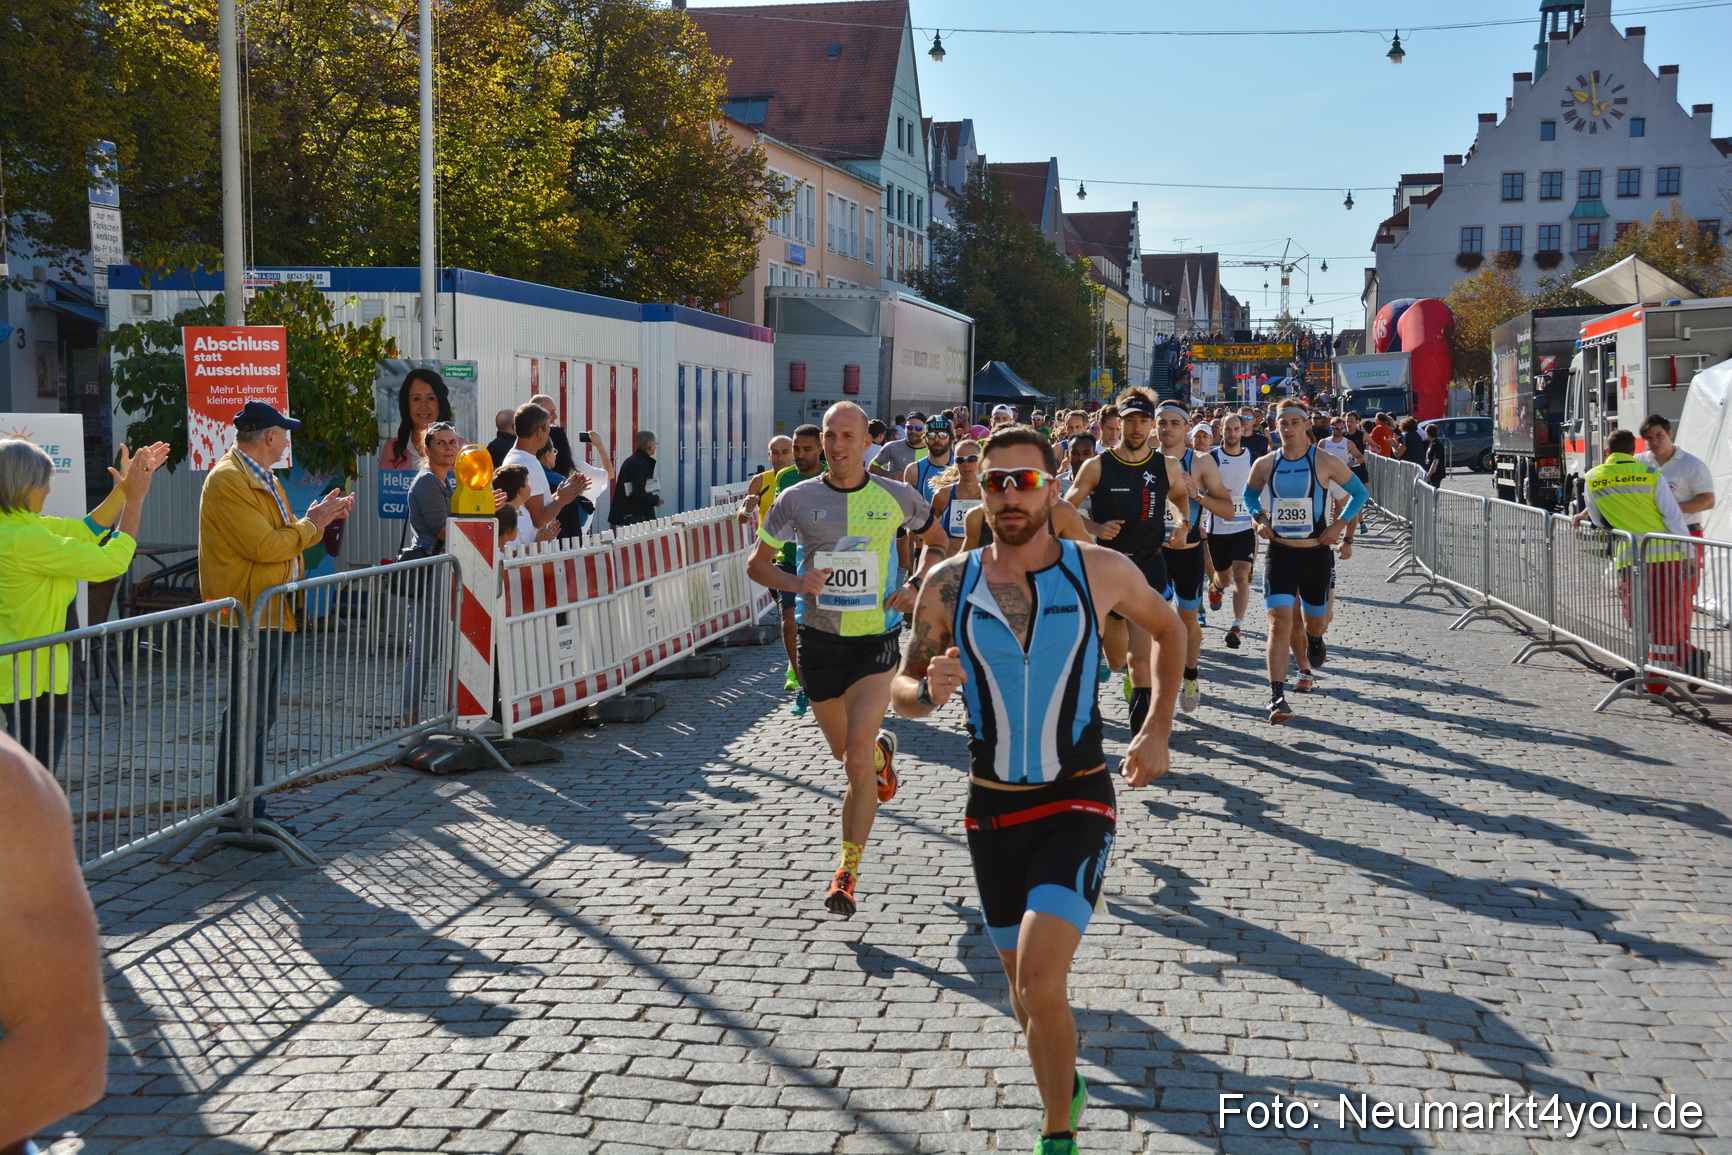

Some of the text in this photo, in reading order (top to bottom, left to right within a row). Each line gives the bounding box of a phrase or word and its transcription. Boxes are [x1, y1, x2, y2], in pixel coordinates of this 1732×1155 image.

[96, 212, 115, 221] nur mit
[93, 220, 119, 232] Parkschein
[96, 232, 118, 244] werktags
[16, 327, 26, 349] 3
[193, 336, 279, 351] Abschluss
[194, 353, 222, 362] statt
[1224, 347, 1260, 357] START
[195, 363, 280, 376] Ausschluss!
[210, 384, 278, 394] Mehr Lehrer für
[207, 395, 242, 405] kleinere
[930, 421, 949, 429] KULT
[1592, 475, 1648, 488] Org.-Leiter
[382, 503, 404, 513] CSU
[1148, 491, 1156, 518] TRIATHLON
[1277, 508, 1307, 521] 2393
[833, 557, 860, 566] BOCK
[824, 568, 867, 587] 2001
[833, 596, 860, 605] Florian
